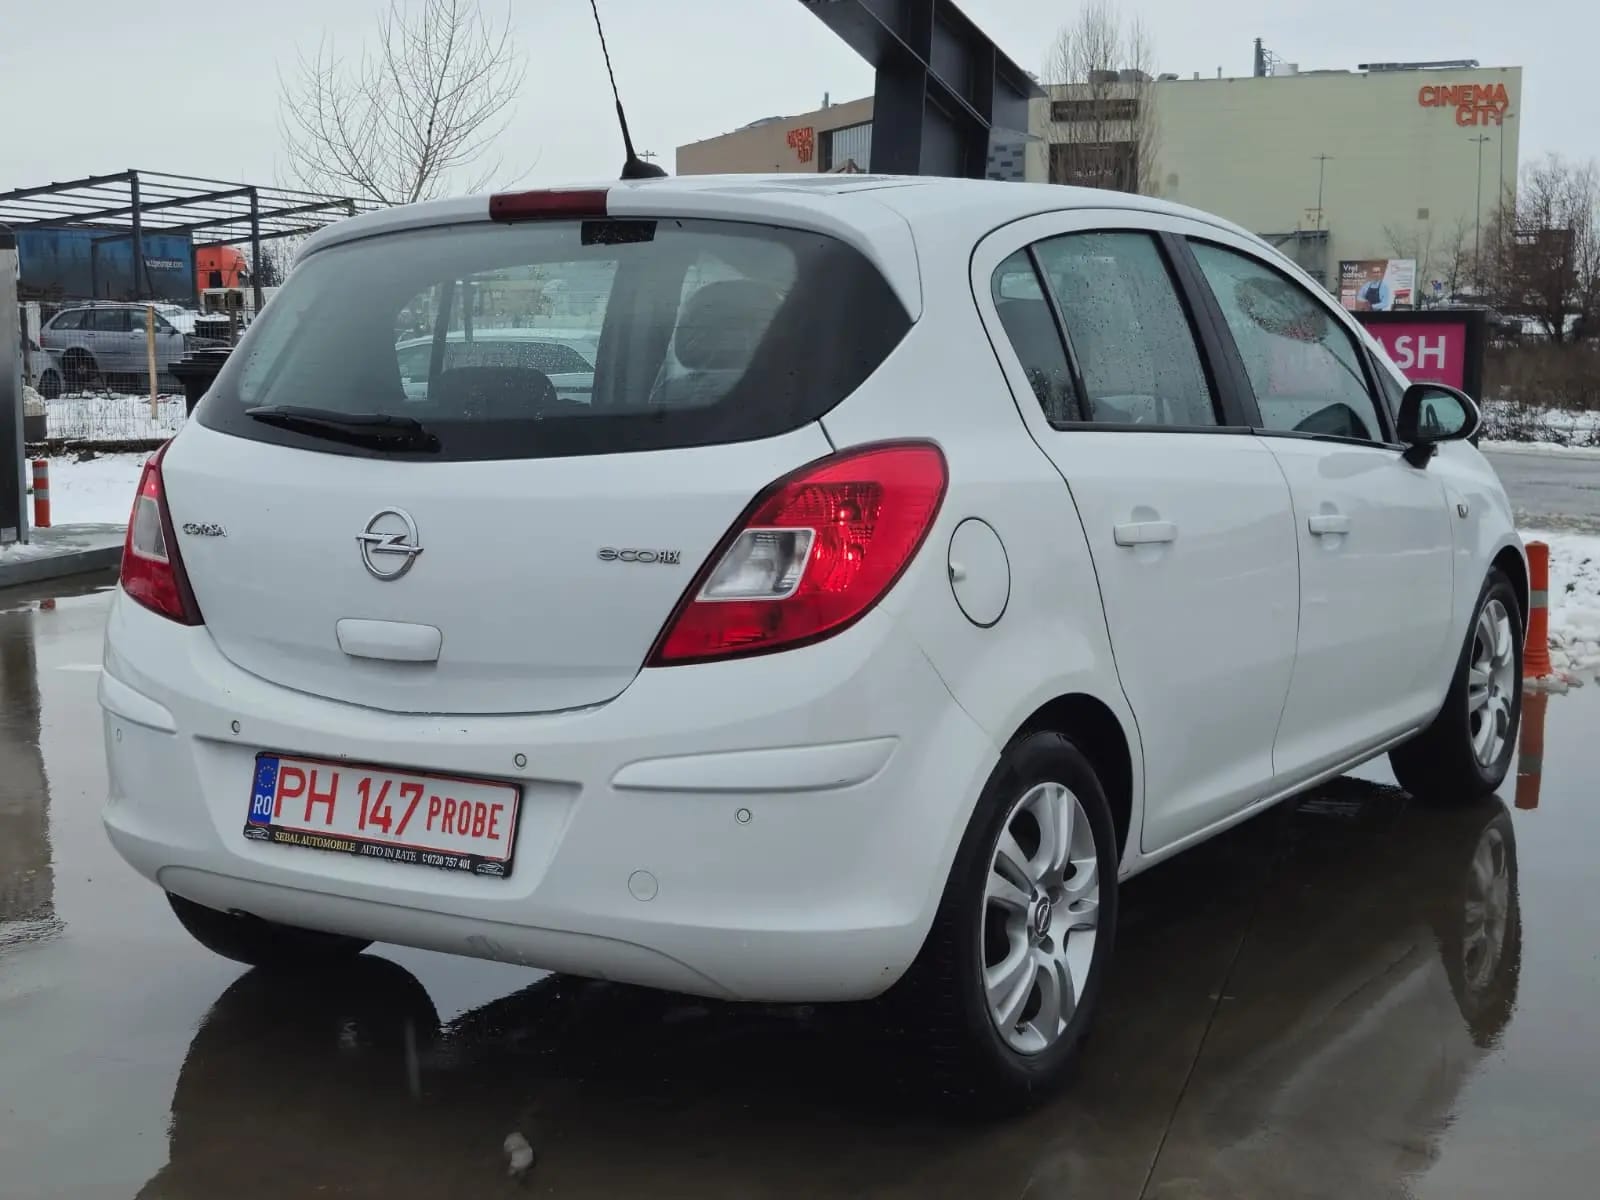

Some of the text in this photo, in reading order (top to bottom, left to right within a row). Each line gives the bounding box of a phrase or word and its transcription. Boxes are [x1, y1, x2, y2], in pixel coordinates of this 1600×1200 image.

[1418, 83, 1508, 107] CINEMA
[1456, 104, 1508, 126] CITY
[253, 794, 272, 815] RO
[274, 766, 504, 840] PH 147 PROBE
[274, 831, 300, 844] SEBAL
[301, 835, 356, 852] AUTOMOBILE
[360, 844, 384, 857] AUTO
[384, 848, 395, 858] IN
[394, 850, 417, 862] RATE
